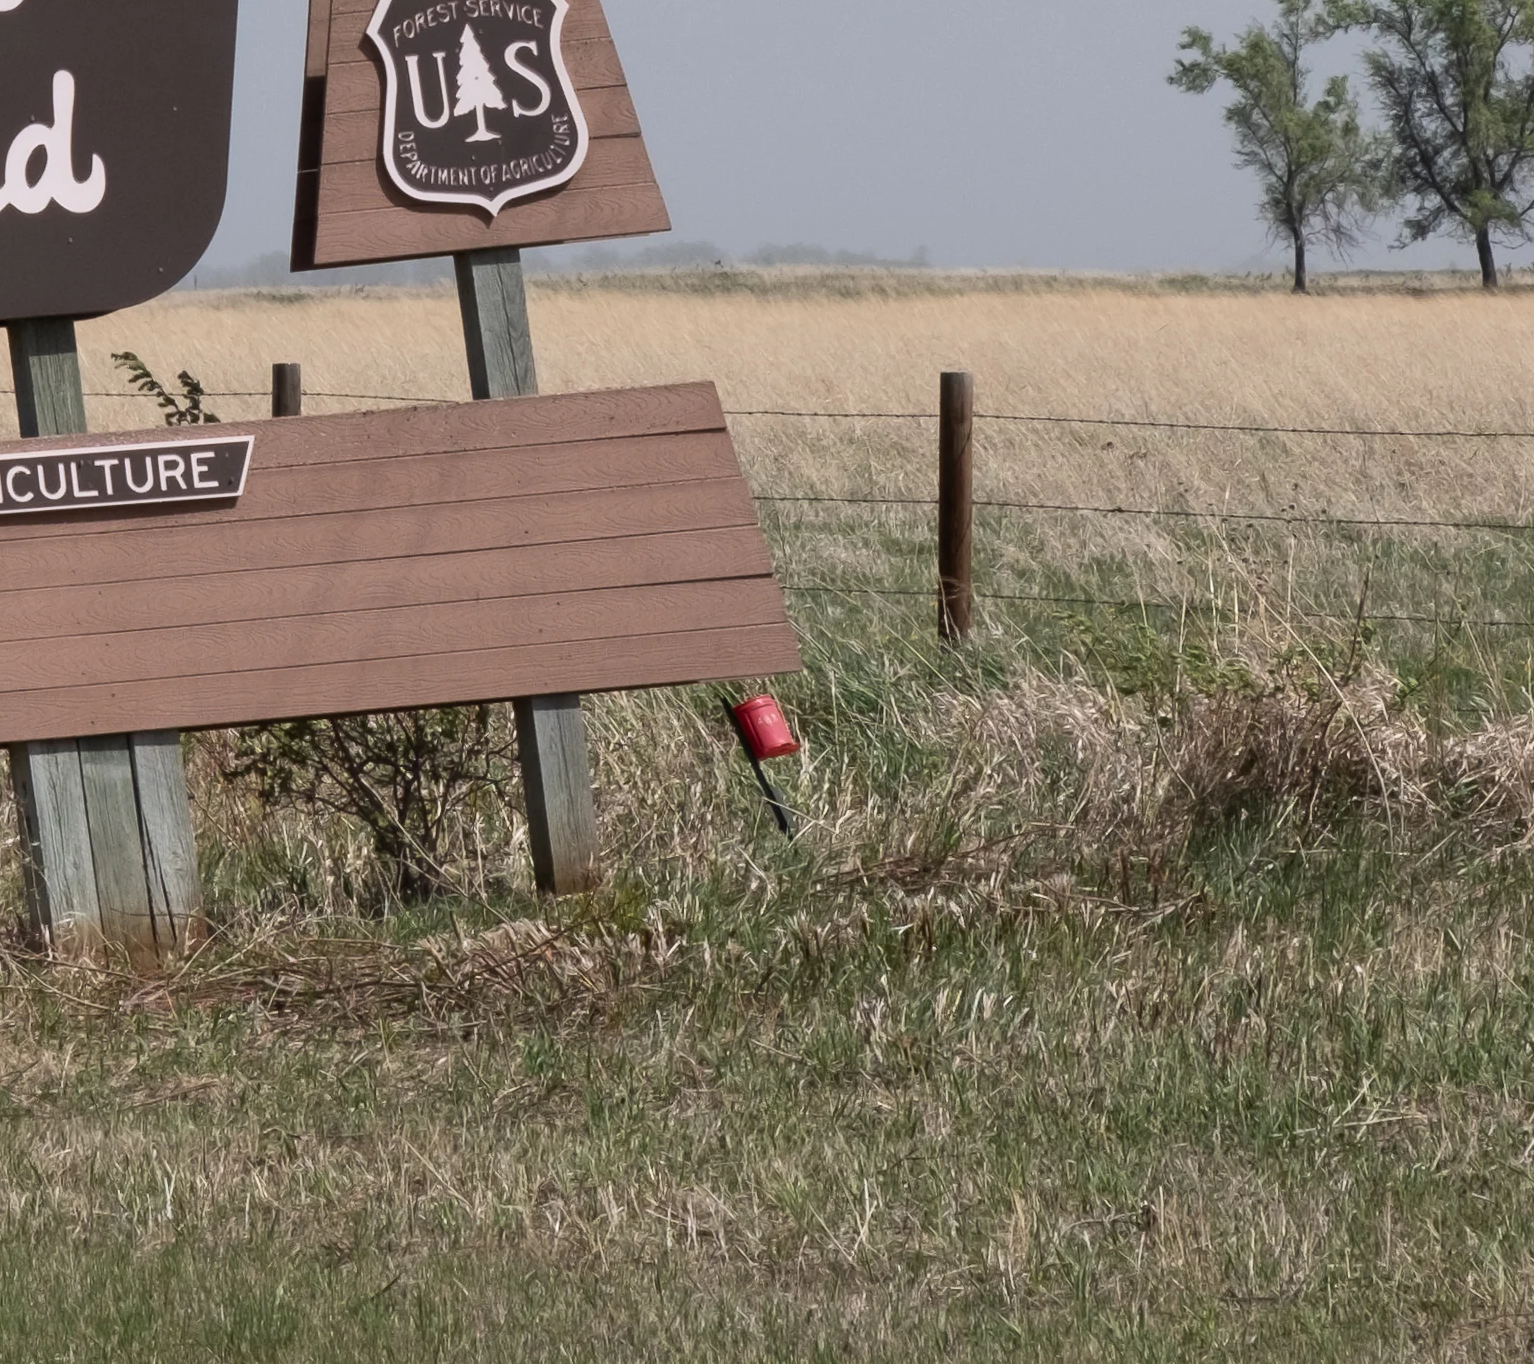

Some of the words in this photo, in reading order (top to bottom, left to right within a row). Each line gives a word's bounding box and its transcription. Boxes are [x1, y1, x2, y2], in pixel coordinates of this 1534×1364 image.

[393, 0, 458, 48] FOREST
[397, 130, 479, 186] DEPARTMENT
[480, 164, 499, 185] OF
[501, 113, 571, 182] AGRICULTURE
